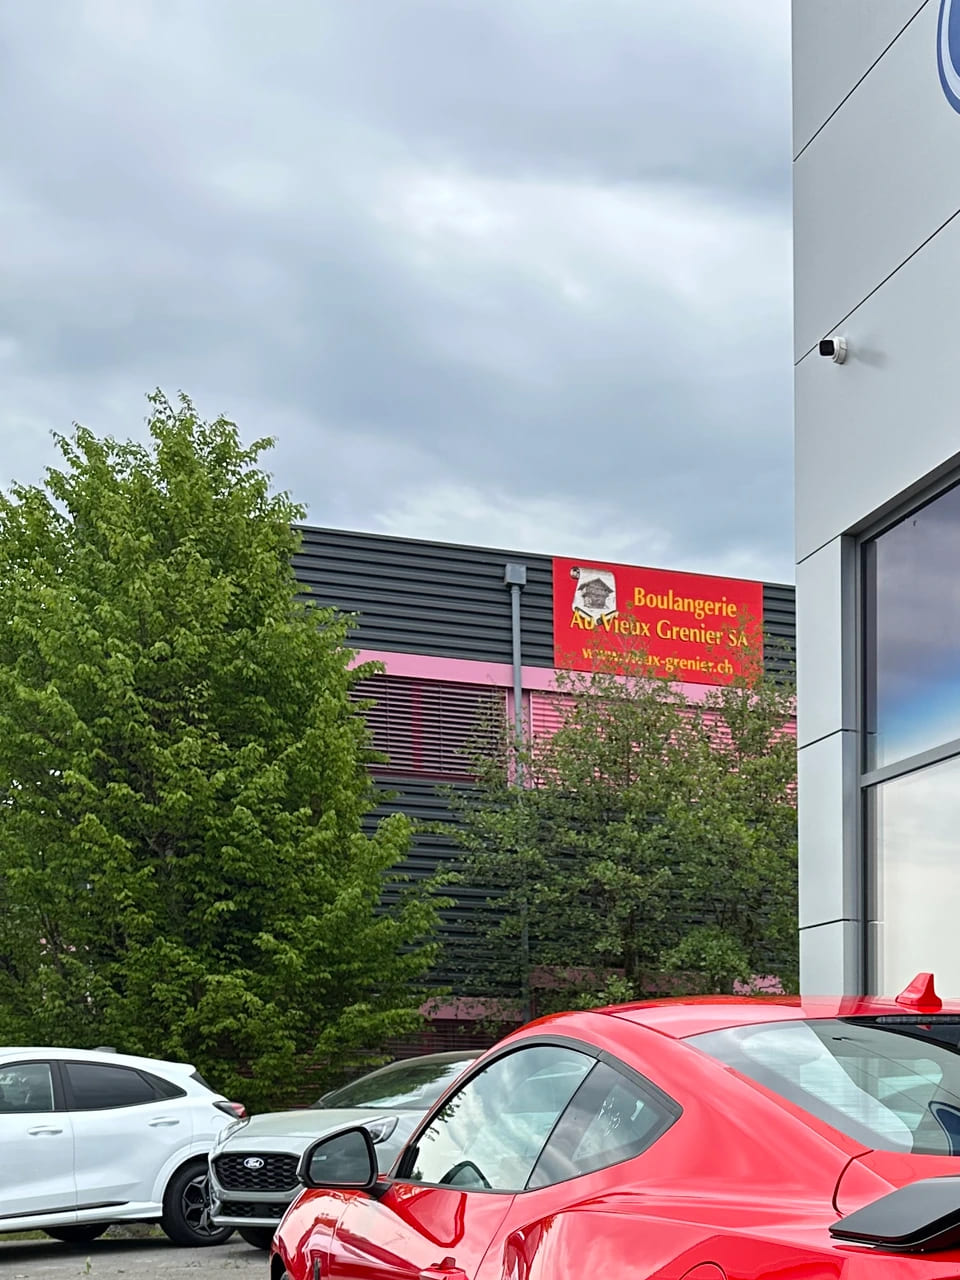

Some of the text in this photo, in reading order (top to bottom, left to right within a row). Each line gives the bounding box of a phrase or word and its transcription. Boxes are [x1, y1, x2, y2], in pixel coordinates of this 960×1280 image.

[634, 587, 737, 619] Boulangerie
[570, 610, 749, 647] Au Vieux Grenier SA
